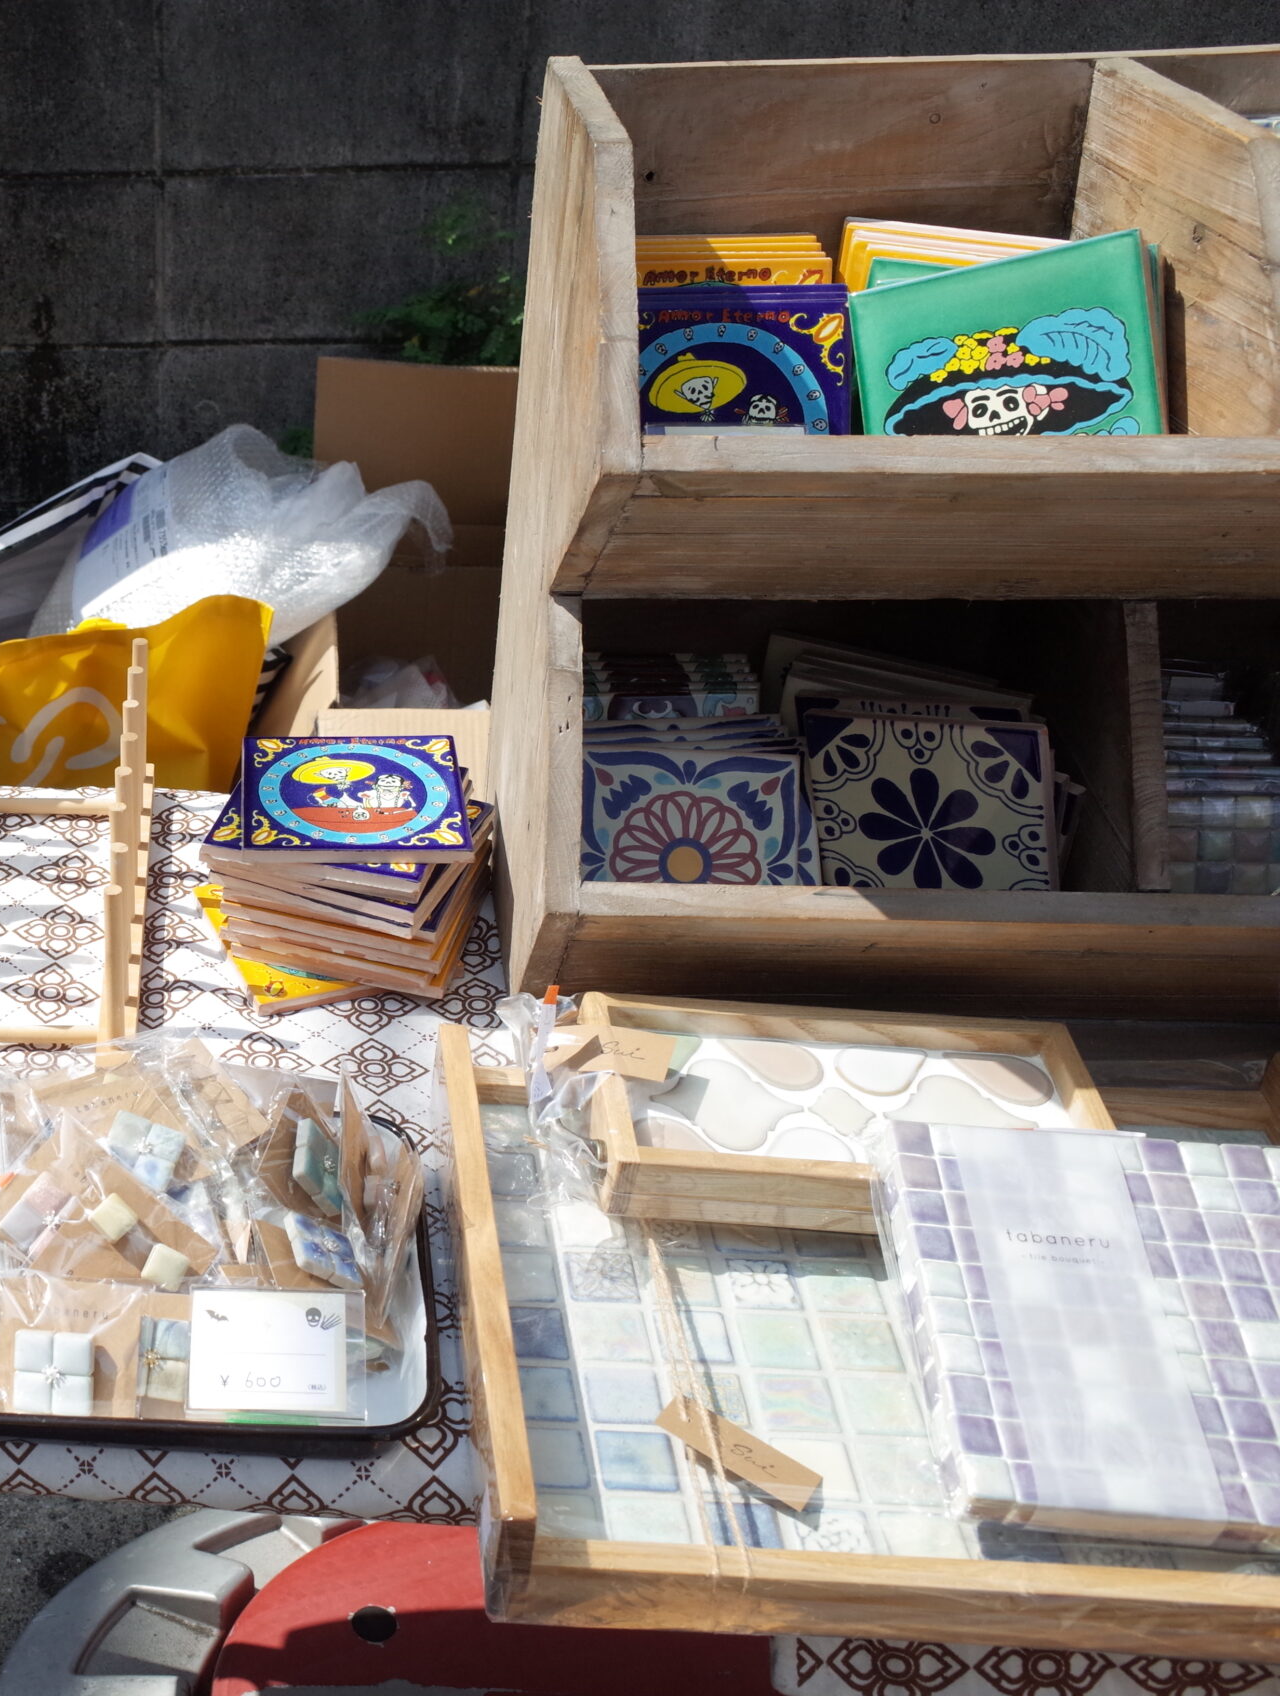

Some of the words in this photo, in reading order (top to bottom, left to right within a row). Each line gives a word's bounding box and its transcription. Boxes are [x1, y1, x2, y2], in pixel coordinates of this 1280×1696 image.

[643, 268, 699, 286] Amor
[705, 265, 772, 283] Eterno
[658, 309, 713, 323] Amor
[721, 308, 791, 323] Eterno
[1005, 1228, 1111, 1249] tabaneru
[244, 1371, 282, 1389] 600
